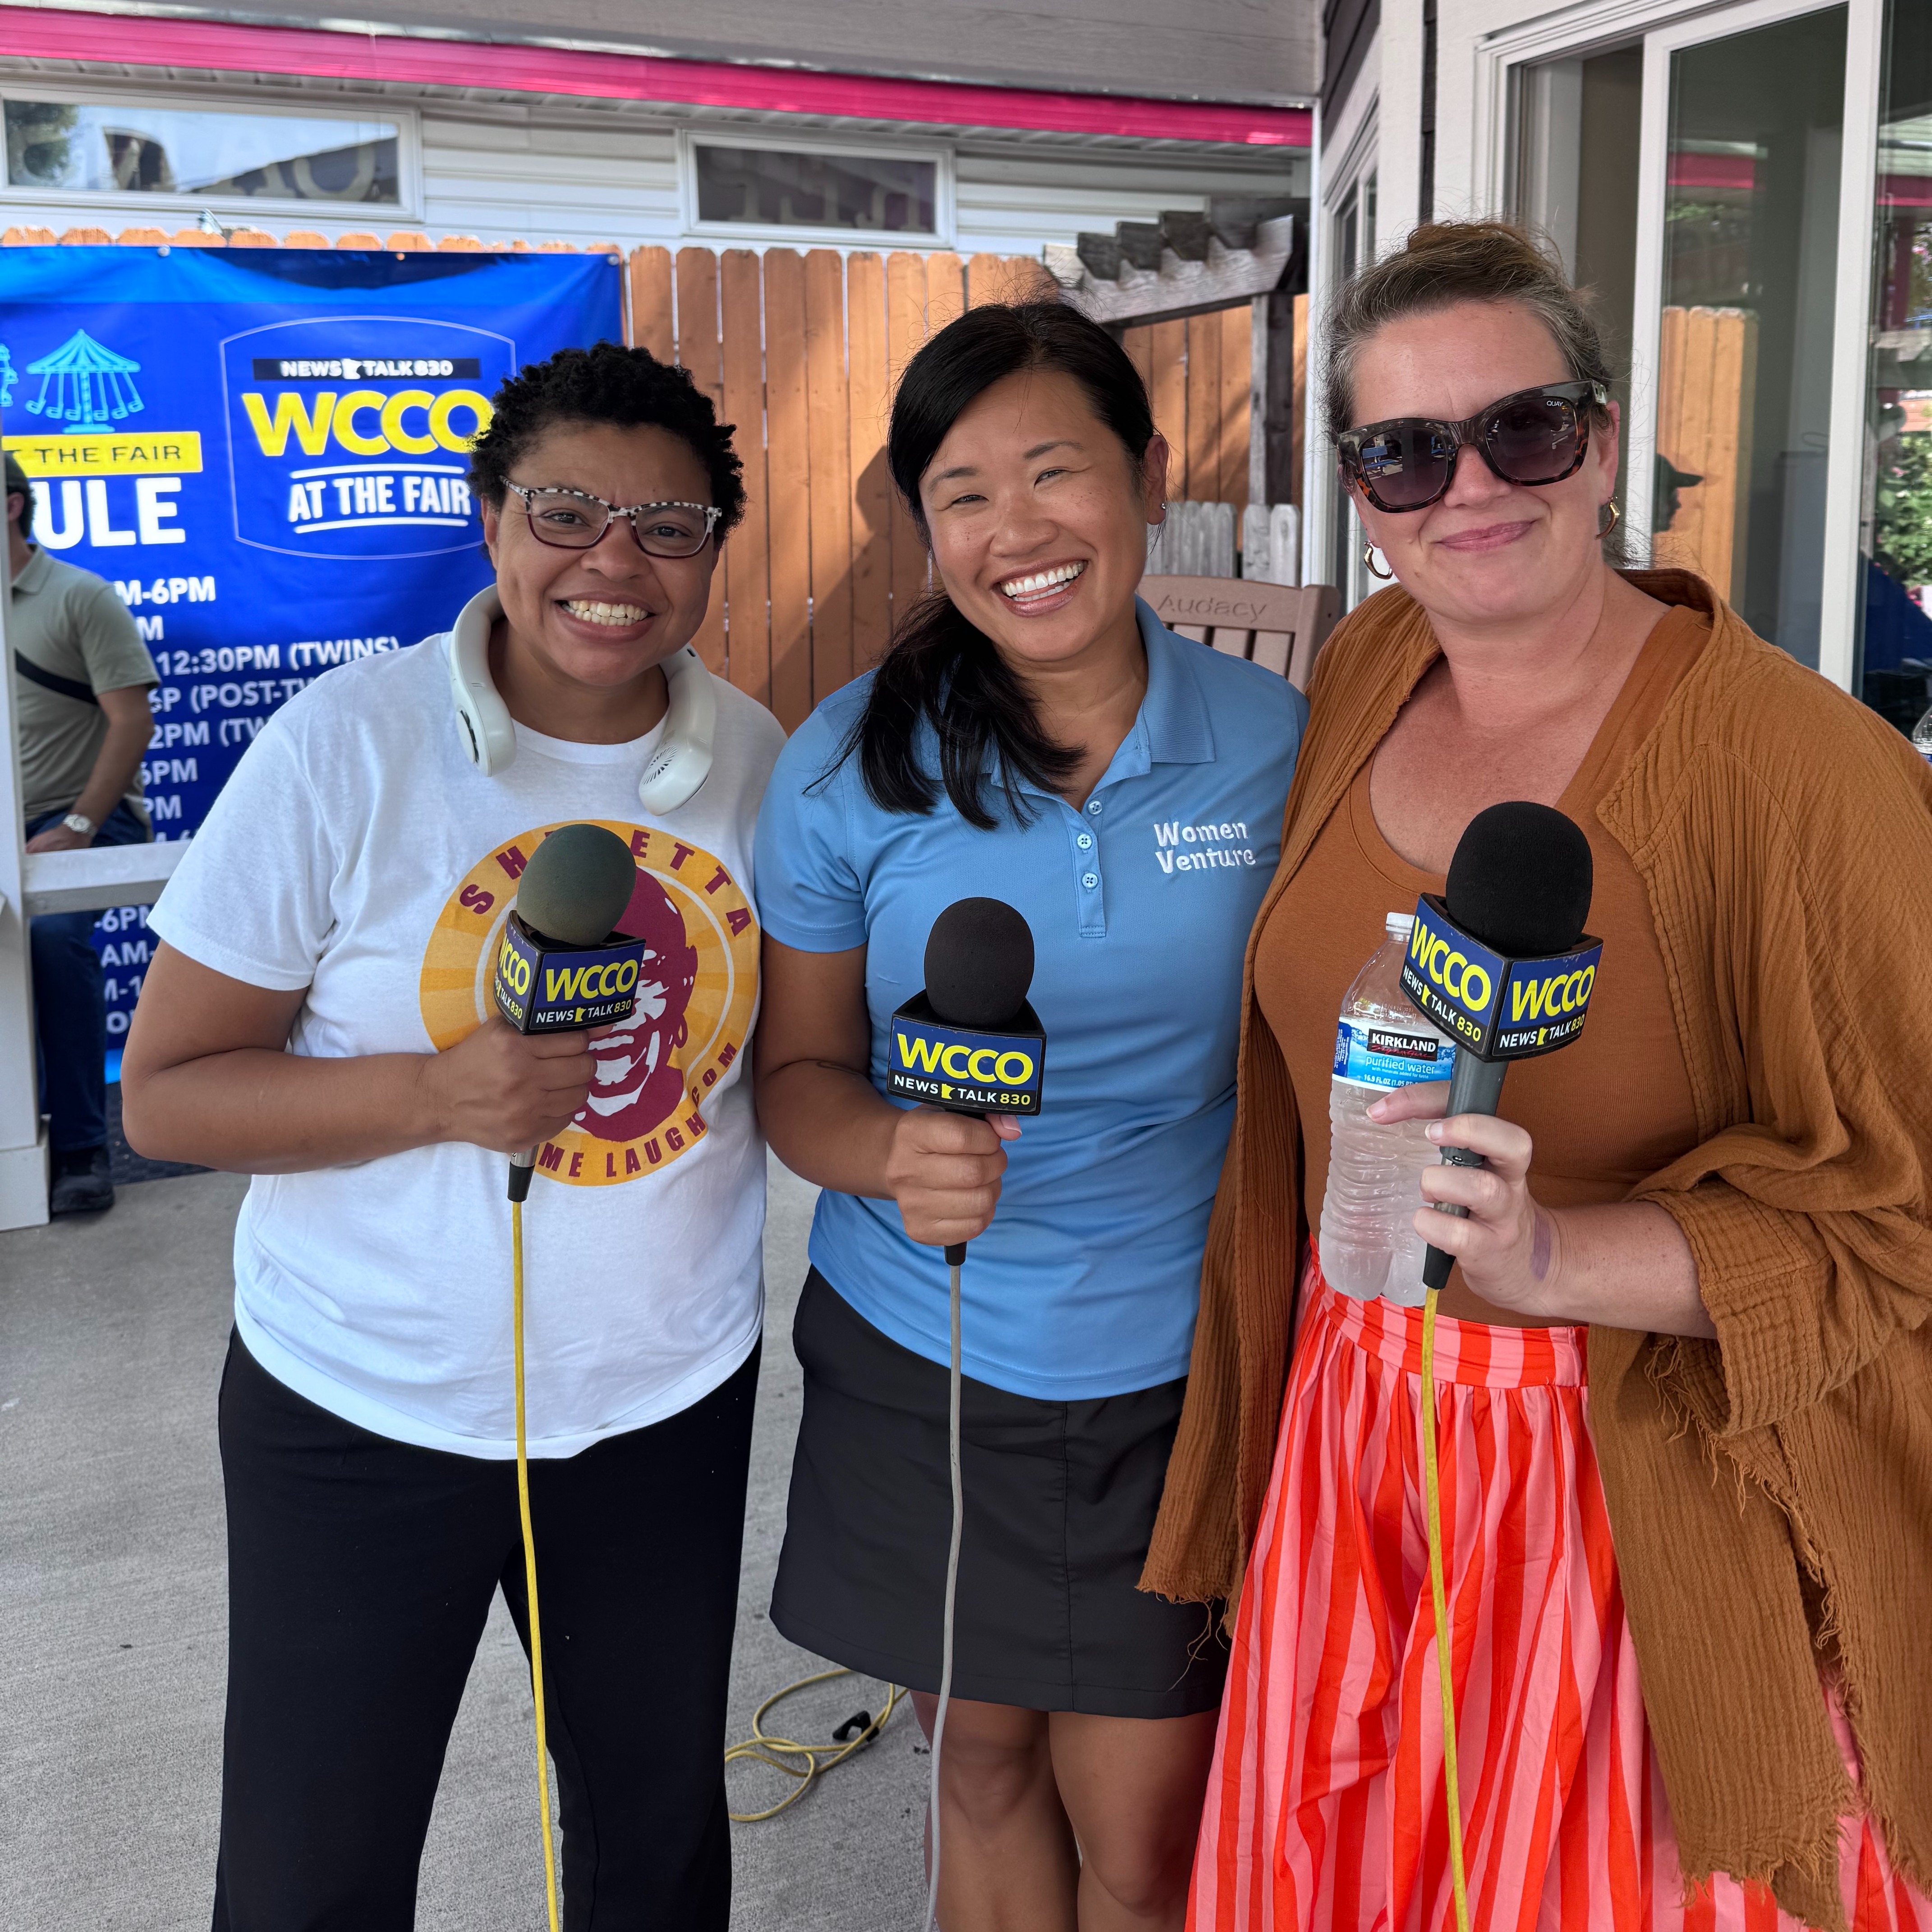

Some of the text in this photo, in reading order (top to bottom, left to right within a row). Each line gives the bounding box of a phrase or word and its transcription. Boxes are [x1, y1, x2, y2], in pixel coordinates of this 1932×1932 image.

[281, 360, 453, 376] NEWS TALK 830
[242, 390, 495, 456] WCCO
[35, 445, 181, 463] THE FAIR
[289, 476, 471, 522] AT THE FAIR
[1158, 595, 1267, 624] Audacy
[156, 644, 280, 676] 12:30PM
[1154, 821, 1248, 846] Women
[1155, 848, 1256, 874] Venture
[459, 830, 752, 937] SHETTA
[1411, 915, 1491, 1011] WCCO
[546, 959, 638, 1002] WCCO
[1512, 965, 1595, 1021] WCCO
[500, 988, 522, 1019] TALK 830
[536, 999, 631, 1023] NEWS TALK 830
[1403, 965, 1423, 995] NEWS
[1431, 994, 1457, 1025] TALK
[1457, 1016, 1481, 1042] 830
[1372, 1033, 1436, 1052] KIRKLAND
[1500, 1014, 1585, 1048] NEWS TALK 830
[897, 1033, 1034, 1085] WCCO
[1366, 1056, 1435, 1074] purified water
[894, 1074, 1030, 1105] NEWS TALK 830
[538, 1143, 583, 1177] ME
[607, 1111, 707, 1177] LAUGH
